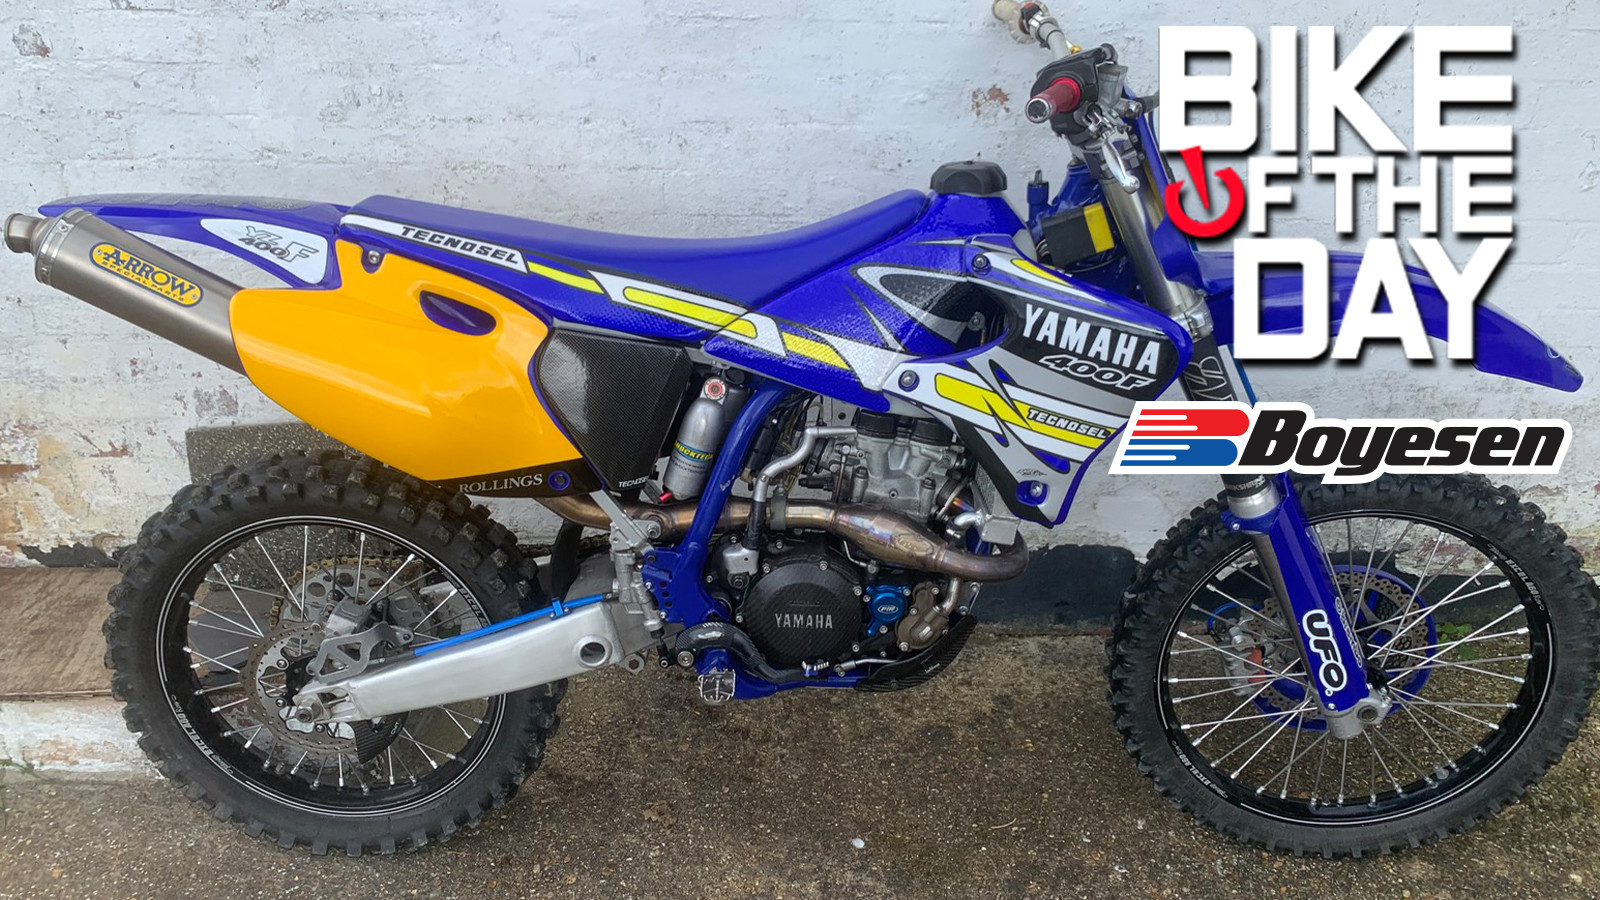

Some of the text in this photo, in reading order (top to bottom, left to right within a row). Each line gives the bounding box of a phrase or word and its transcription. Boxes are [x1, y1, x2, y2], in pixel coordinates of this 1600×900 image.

[402, 226, 518, 264] TECNOSEL
[101, 260, 185, 302] SPECIAL PARTS
[103, 249, 195, 296] ARROW
[1023, 303, 1161, 375] YAMAHA
[1038, 354, 1157, 390] 400F
[1026, 407, 1109, 439] TECNOSEL
[459, 473, 544, 493] ROLLINGS
[775, 613, 833, 629] YAMAHA
[189, 728, 214, 756] EXCEL
